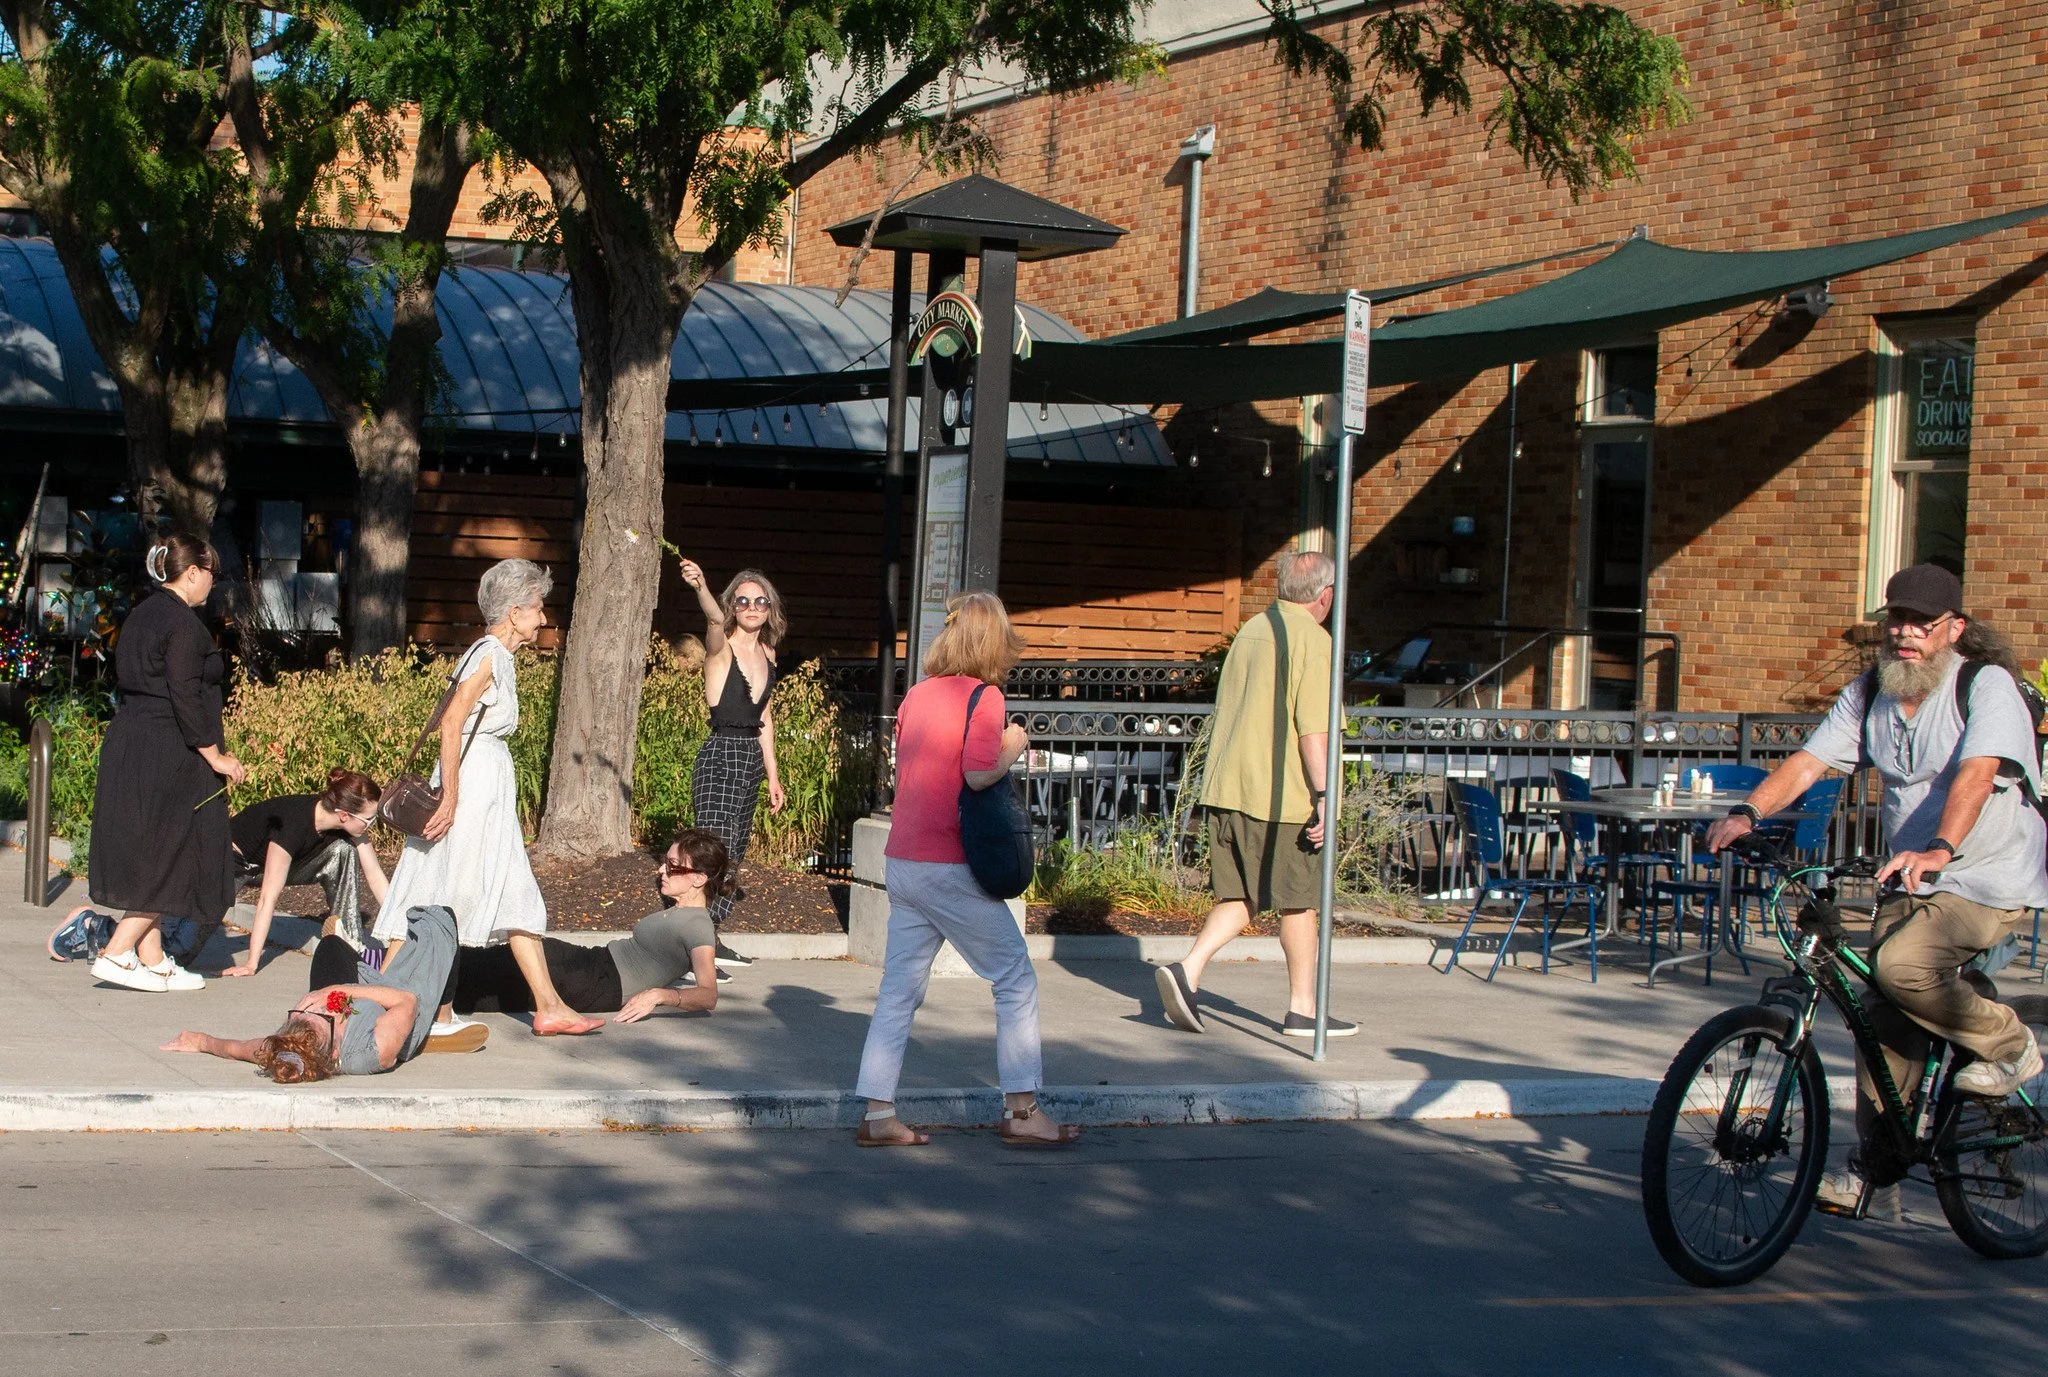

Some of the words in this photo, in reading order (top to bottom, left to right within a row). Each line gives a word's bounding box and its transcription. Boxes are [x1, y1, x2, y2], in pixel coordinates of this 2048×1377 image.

[918, 307, 935, 337] CITY
[938, 302, 968, 330] MARKET
[1921, 356, 1972, 398] EAT
[1916, 429, 1969, 446] SOCIALIZ
